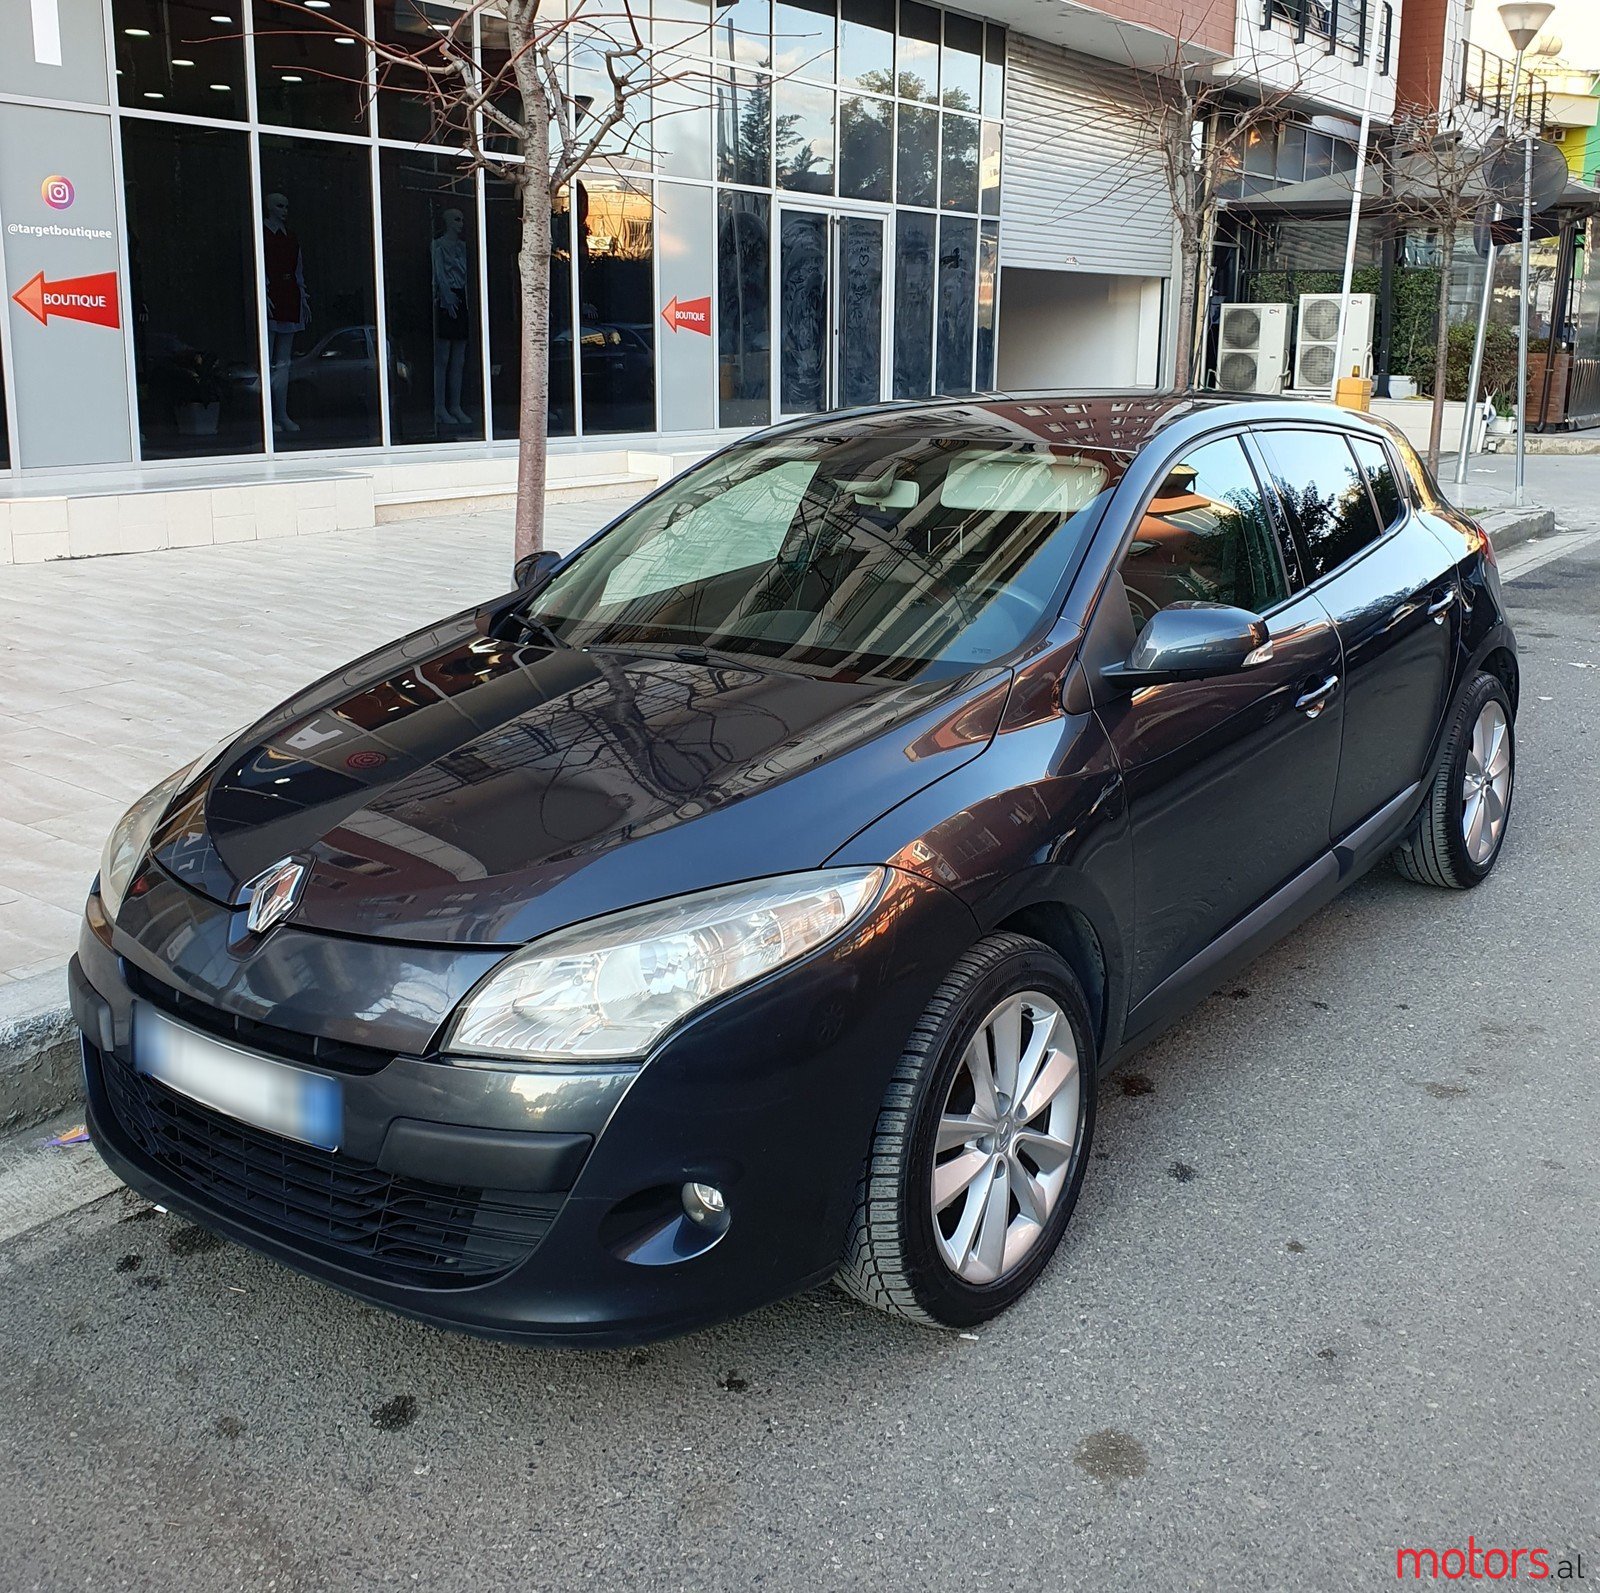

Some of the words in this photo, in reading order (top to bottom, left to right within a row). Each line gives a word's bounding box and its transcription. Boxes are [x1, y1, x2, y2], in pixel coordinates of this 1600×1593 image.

[7, 223, 112, 240] @targetboutiquee
[43, 293, 107, 308] BOUTIQUE
[675, 310, 706, 322] BOUTIQUE
